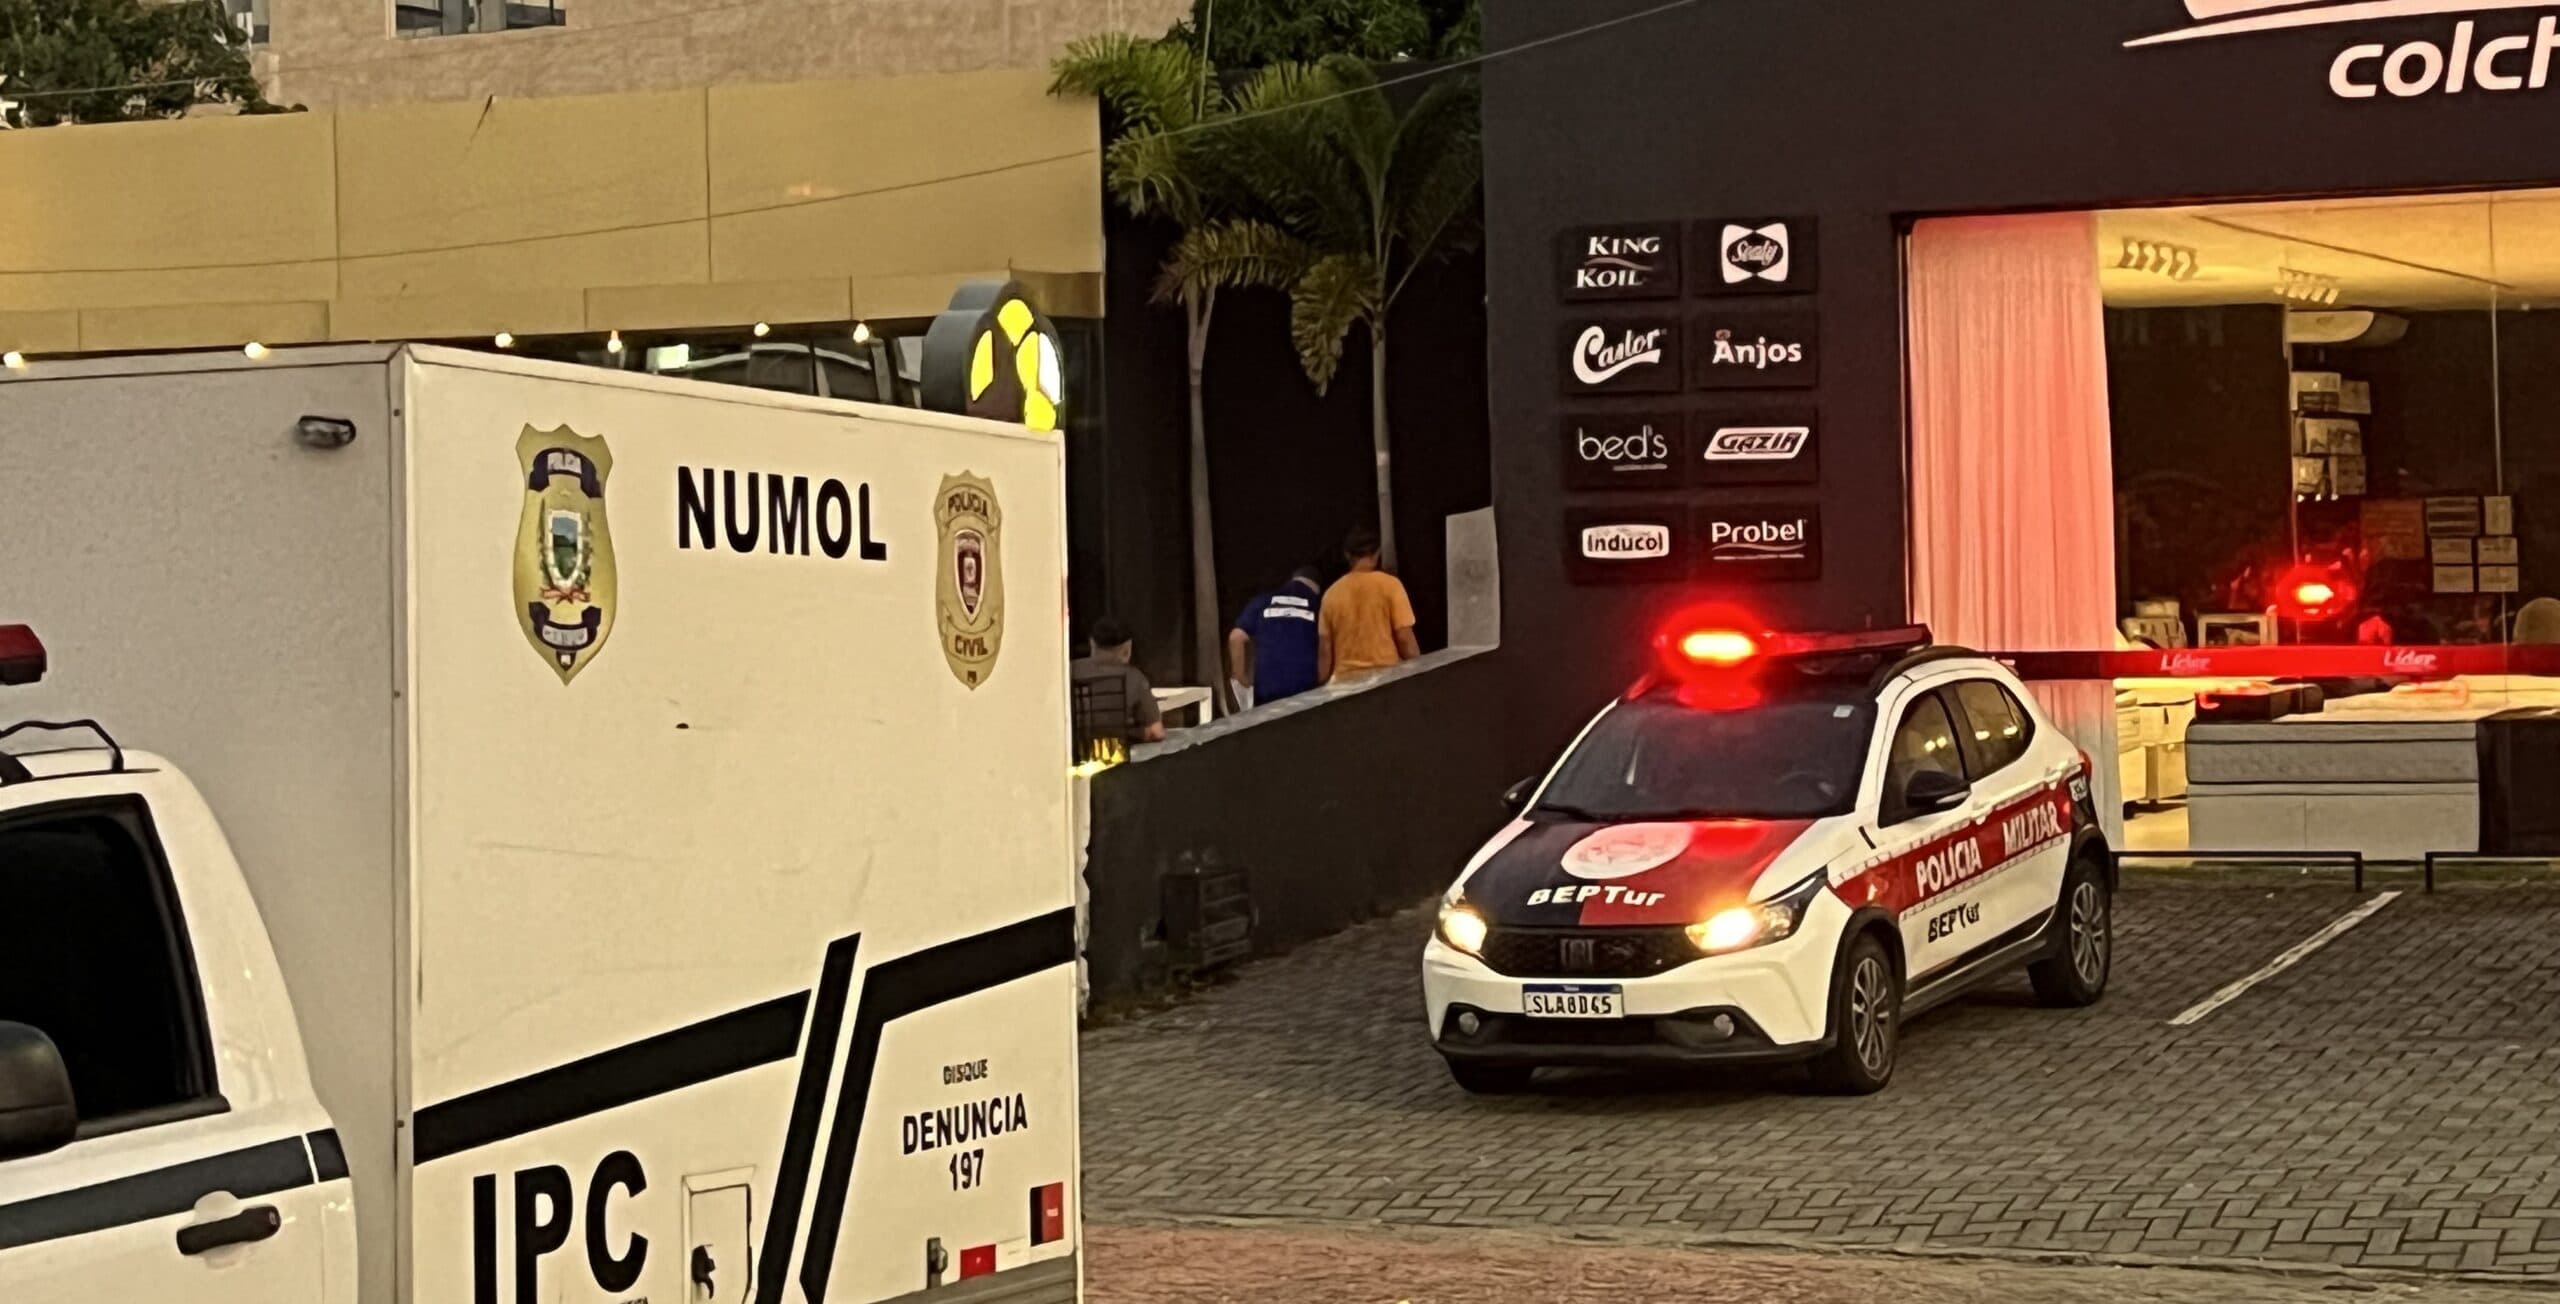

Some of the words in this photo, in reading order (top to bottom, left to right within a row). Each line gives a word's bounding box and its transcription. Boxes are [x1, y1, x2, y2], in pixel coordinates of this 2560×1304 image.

[1588, 236, 1661, 255] KING
[1576, 268, 1644, 288] KOIL
[1712, 336, 1802, 369] Anjos
[1578, 424, 1668, 460] bed's
[677, 466, 888, 561] NUMOL
[1587, 531, 1664, 552] Inducol
[1711, 519, 1804, 543] Probel
[1914, 836, 1984, 898] POLÍCIA
[2001, 800, 2064, 857] MILITAR
[1526, 885, 1666, 906] BEPTur
[902, 1092, 1028, 1155] DENUNCIA
[948, 1147, 985, 1192] 197
[472, 1150, 648, 1304] IPC
